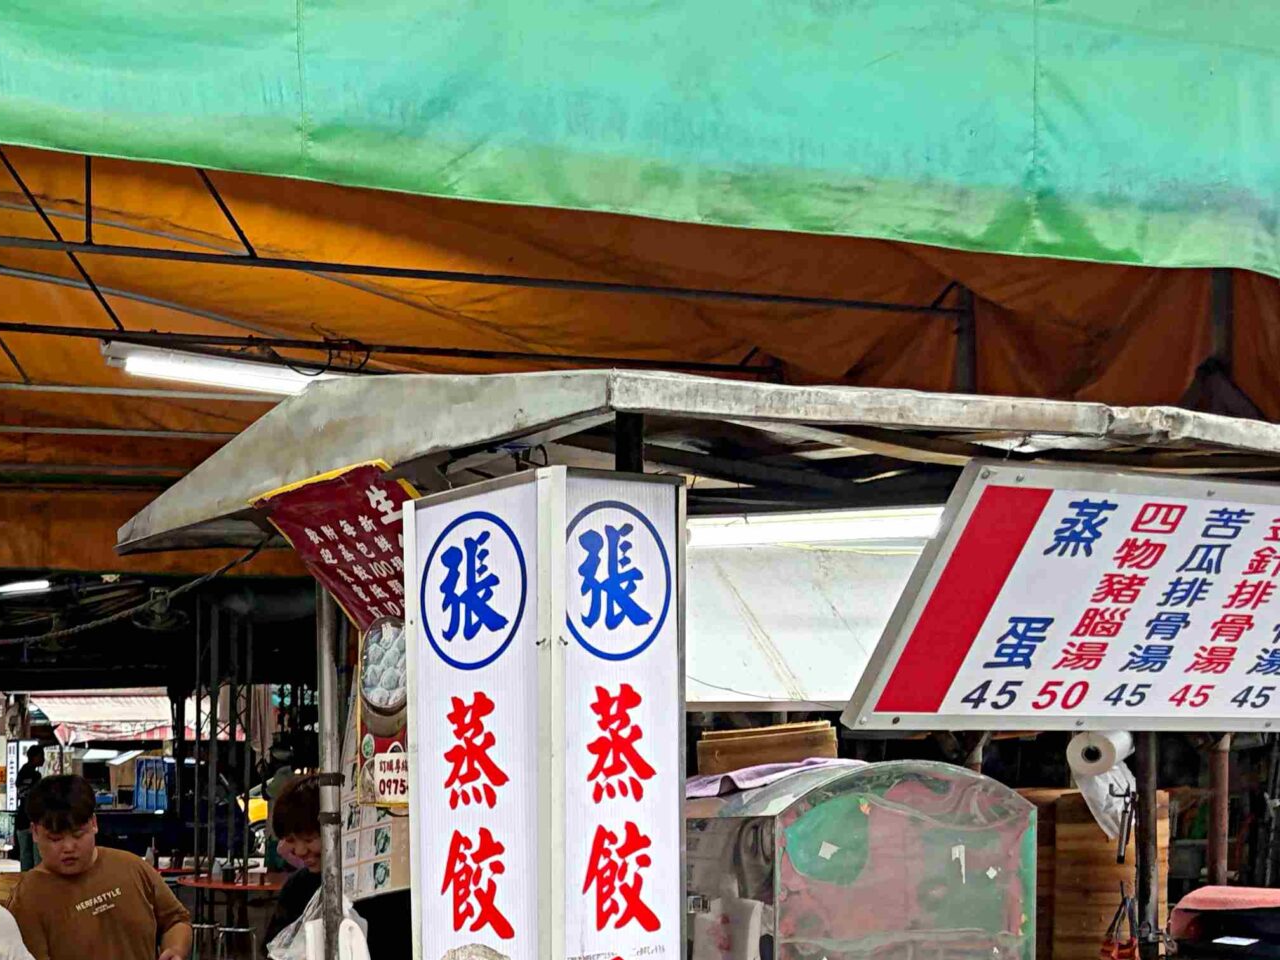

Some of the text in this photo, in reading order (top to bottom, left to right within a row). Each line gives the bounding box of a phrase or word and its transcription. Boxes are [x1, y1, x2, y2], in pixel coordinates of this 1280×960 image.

[439, 531, 508, 641] 張
[579, 523, 650, 632] 張
[983, 497, 1118, 669] 蒸蛋
[1052, 502, 1188, 671] 四物豬腦湯
[1118, 507, 1255, 673] 苦瓜排骨湯
[961, 680, 1276, 709] 45 50 45 45 45
